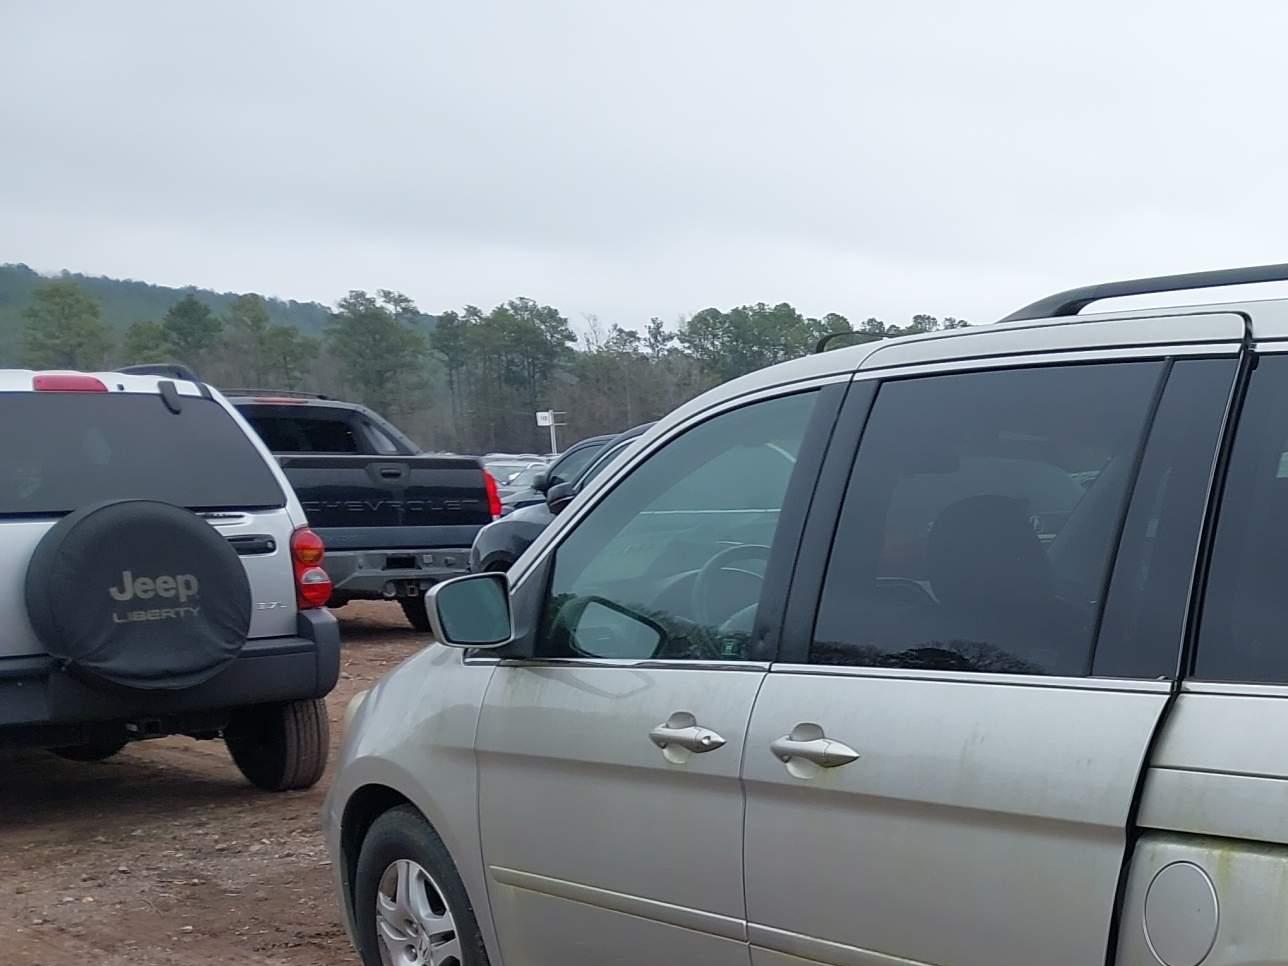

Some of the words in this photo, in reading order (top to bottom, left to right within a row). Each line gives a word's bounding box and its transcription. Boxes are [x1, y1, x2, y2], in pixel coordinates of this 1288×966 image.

[302, 499, 479, 512] CHEVROLET
[109, 570, 200, 602] Jeep
[112, 607, 200, 623] LIBERTY
